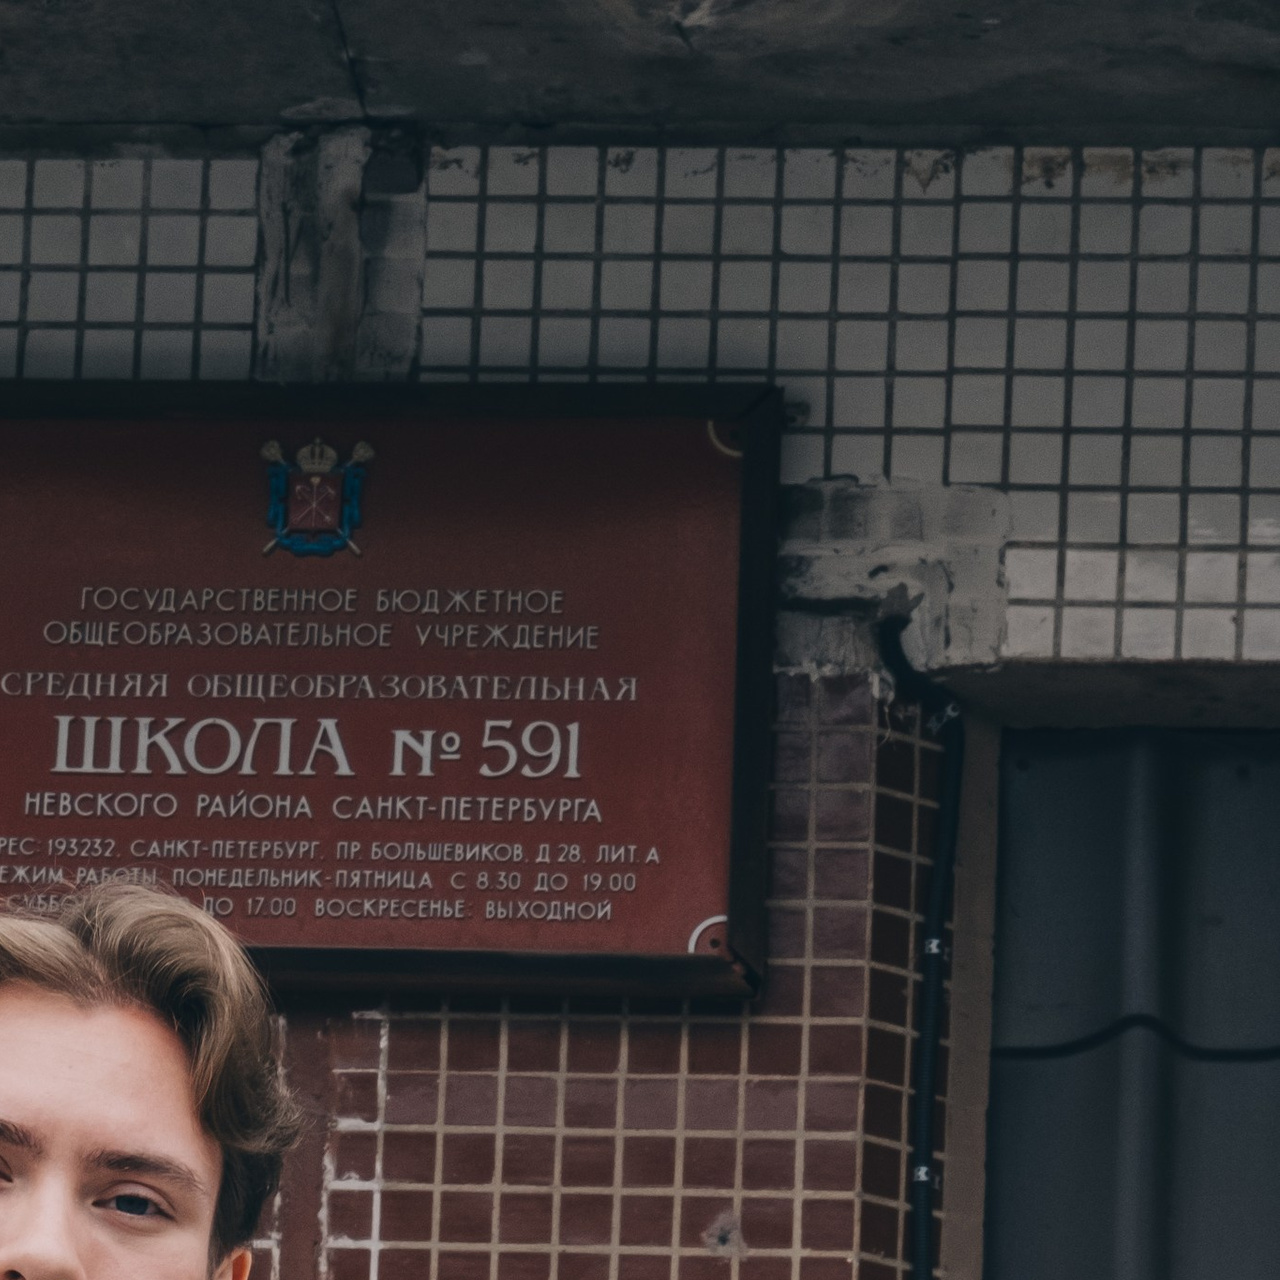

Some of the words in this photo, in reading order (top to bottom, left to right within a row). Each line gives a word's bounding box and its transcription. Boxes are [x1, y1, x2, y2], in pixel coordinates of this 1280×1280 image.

[81, 586, 357, 613] ГОСУДАРСТВЕННОЕ
[376, 588, 564, 615] БЮДЖЕТНОЕ
[43, 621, 392, 648] ОБЩЕОБРАЗОВАТЕЛЬНОЕ
[416, 623, 599, 650] УЧРЕЖДЕНИЕ
[0, 671, 169, 701] СРЕДНЯЯ
[187, 673, 638, 702] ОБЩЕОБРАЗОВАТЕЛЬНАЯ
[50, 715, 356, 776] ШКОЛА
[389, 729, 462, 777] №
[478, 719, 582, 779] 591
[24, 791, 178, 818] НЕВСКОГО
[196, 789, 313, 819] РАЙОНА
[332, 795, 602, 823] САНКТ-ПЕТЕРБУРГА
[645, 846, 661, 864] А
[173, 868, 433, 890] ПОНЕДЕЛЬНИК-ПЯТНИЦА
[450, 872, 467, 890] С
[476, 871, 522, 891] 8.30
[533, 872, 569, 892] ДО
[582, 873, 637, 892] 19.00
[202, 897, 234, 918] ДО
[247, 897, 297, 917] 17.00
[486, 900, 612, 922] ВЫХОДНОЙ
